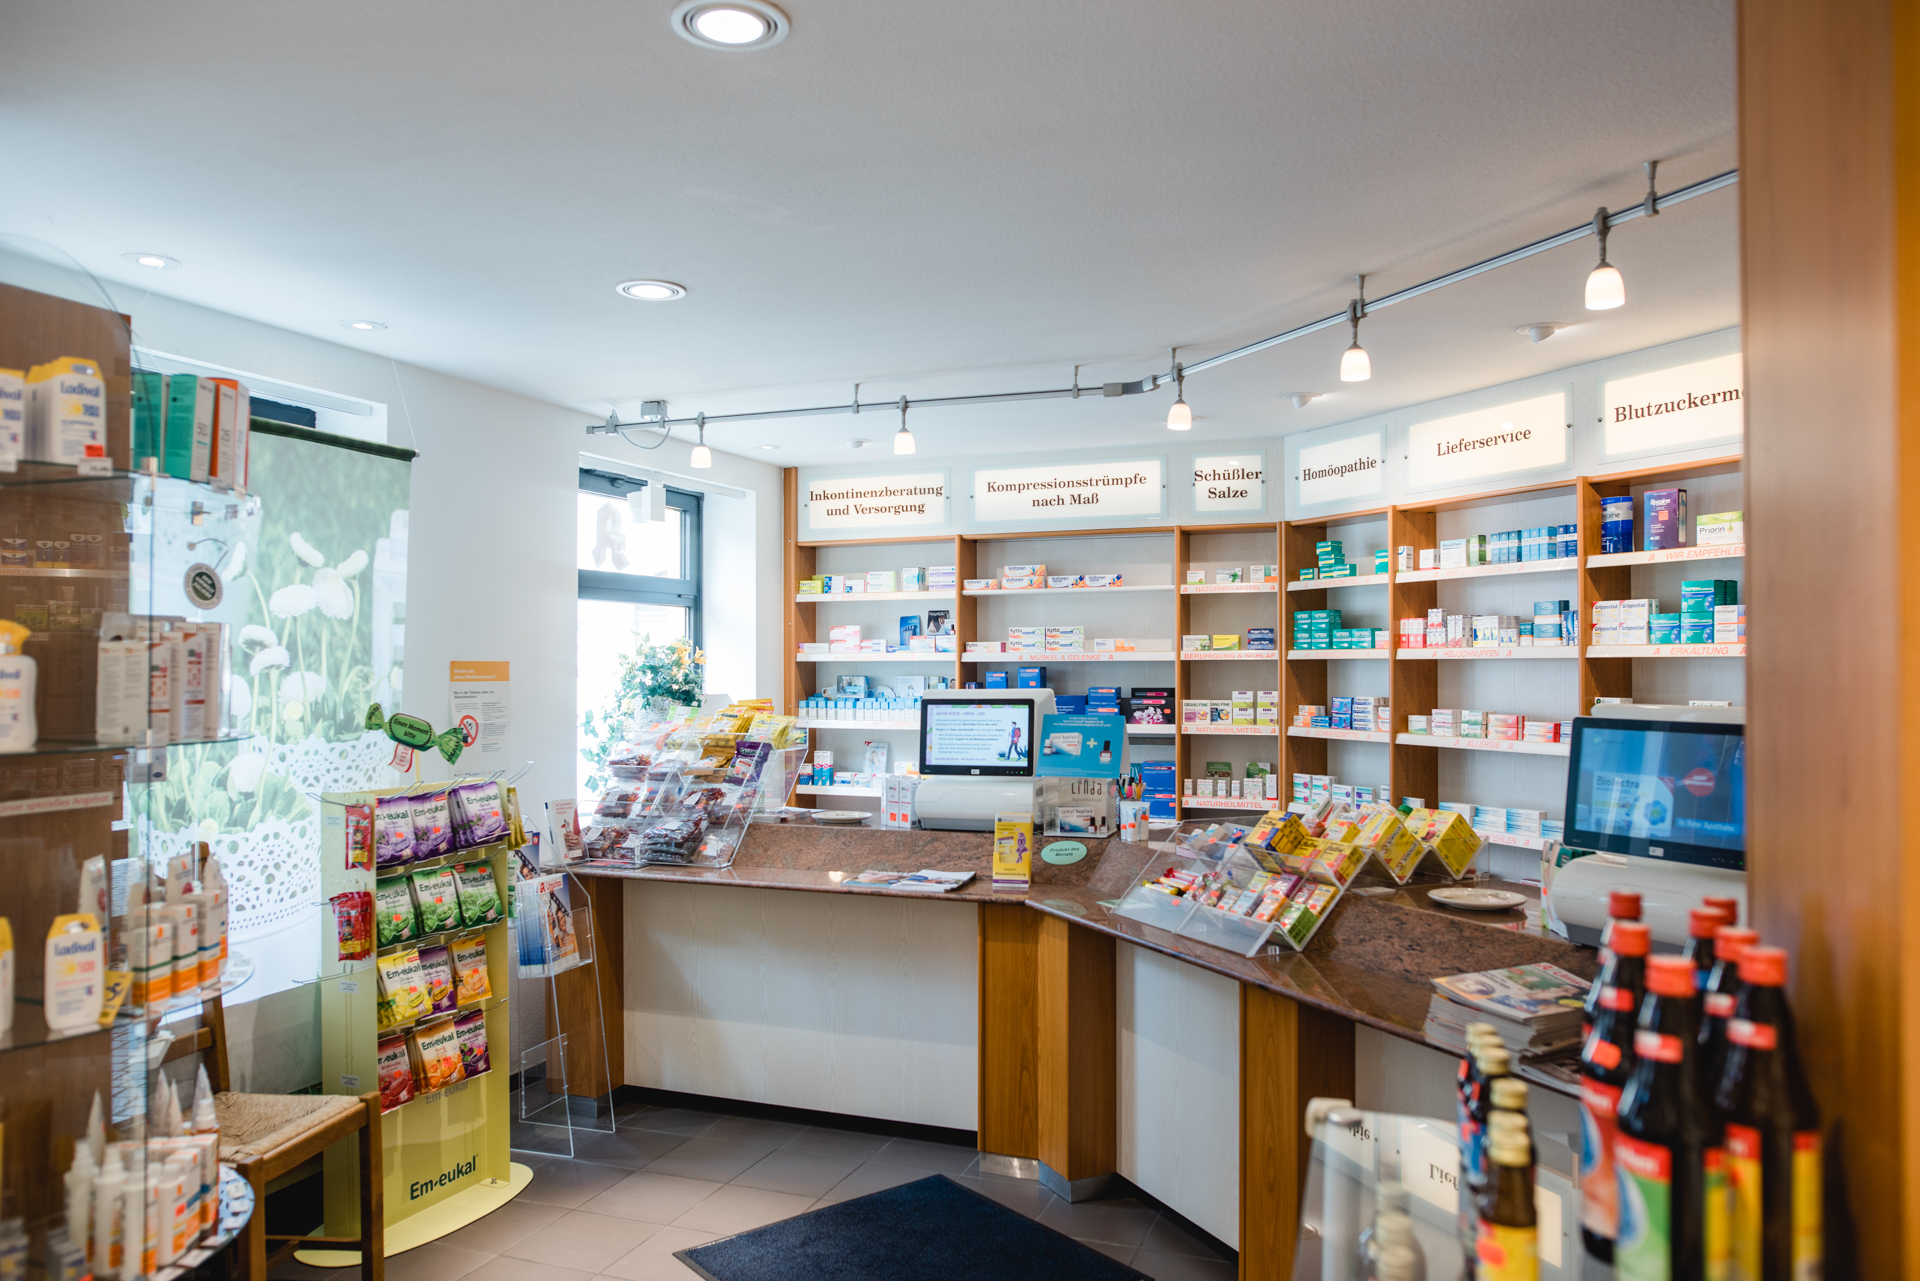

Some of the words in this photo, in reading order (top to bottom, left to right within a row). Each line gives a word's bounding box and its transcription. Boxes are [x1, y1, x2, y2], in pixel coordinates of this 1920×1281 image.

[60, 381, 100, 398] Ladival
[1436, 429, 1532, 457] Lieferservice
[1194, 468, 1262, 482] Schüßler
[1302, 456, 1377, 481] Homöopathie
[987, 473, 1147, 493] Kompressionsstrümpfe
[809, 485, 943, 501] Inkontinenzberatung
[1032, 495, 1065, 507] nach
[1069, 493, 1099, 505] Maß
[1208, 487, 1248, 499] Salze
[826, 505, 850, 516] und
[853, 502, 925, 516] Versorgung
[1650, 498, 1671, 507] Regaine
[1699, 526, 1726, 534] Priorin
[1666, 551, 1685, 560] WIR
[1195, 584, 1262, 592] NATURHEILMITTEL
[1443, 649, 1500, 658] HEUSCHNUPFEN
[1670, 646, 1729, 656] ERKÄLTUNG
[393, 718, 408, 728] Einen
[408, 723, 430, 736] Moment
[1196, 726, 1262, 734] NATURHEILMITTEL
[403, 729, 417, 740] bitte
[1314, 730, 1361, 740] SCHMERZMITTEL
[1466, 740, 1501, 749] ALLERGIE
[26, 798, 70, 812] spezielles
[72, 794, 109, 807] Angebot
[466, 793, 500, 805] Em-eukal
[1196, 800, 1263, 809] NATURHEILMITTEL
[413, 803, 447, 817] Em-eukal
[1703, 821, 1735, 832] Apotheke
[419, 879, 453, 892] Em-eukal
[458, 872, 493, 885] Em-eukal
[54, 938, 96, 957] Ladival
[457, 948, 486, 963] Em-eukal
[421, 958, 449, 971] m-eukal
[386, 964, 421, 980] Em-eukal
[455, 1021, 485, 1039] Em-eukal
[421, 1031, 455, 1051] Em-eukal
[425, 1080, 469, 1105] Em-eukal
[410, 1155, 477, 1201] Em-eukal
